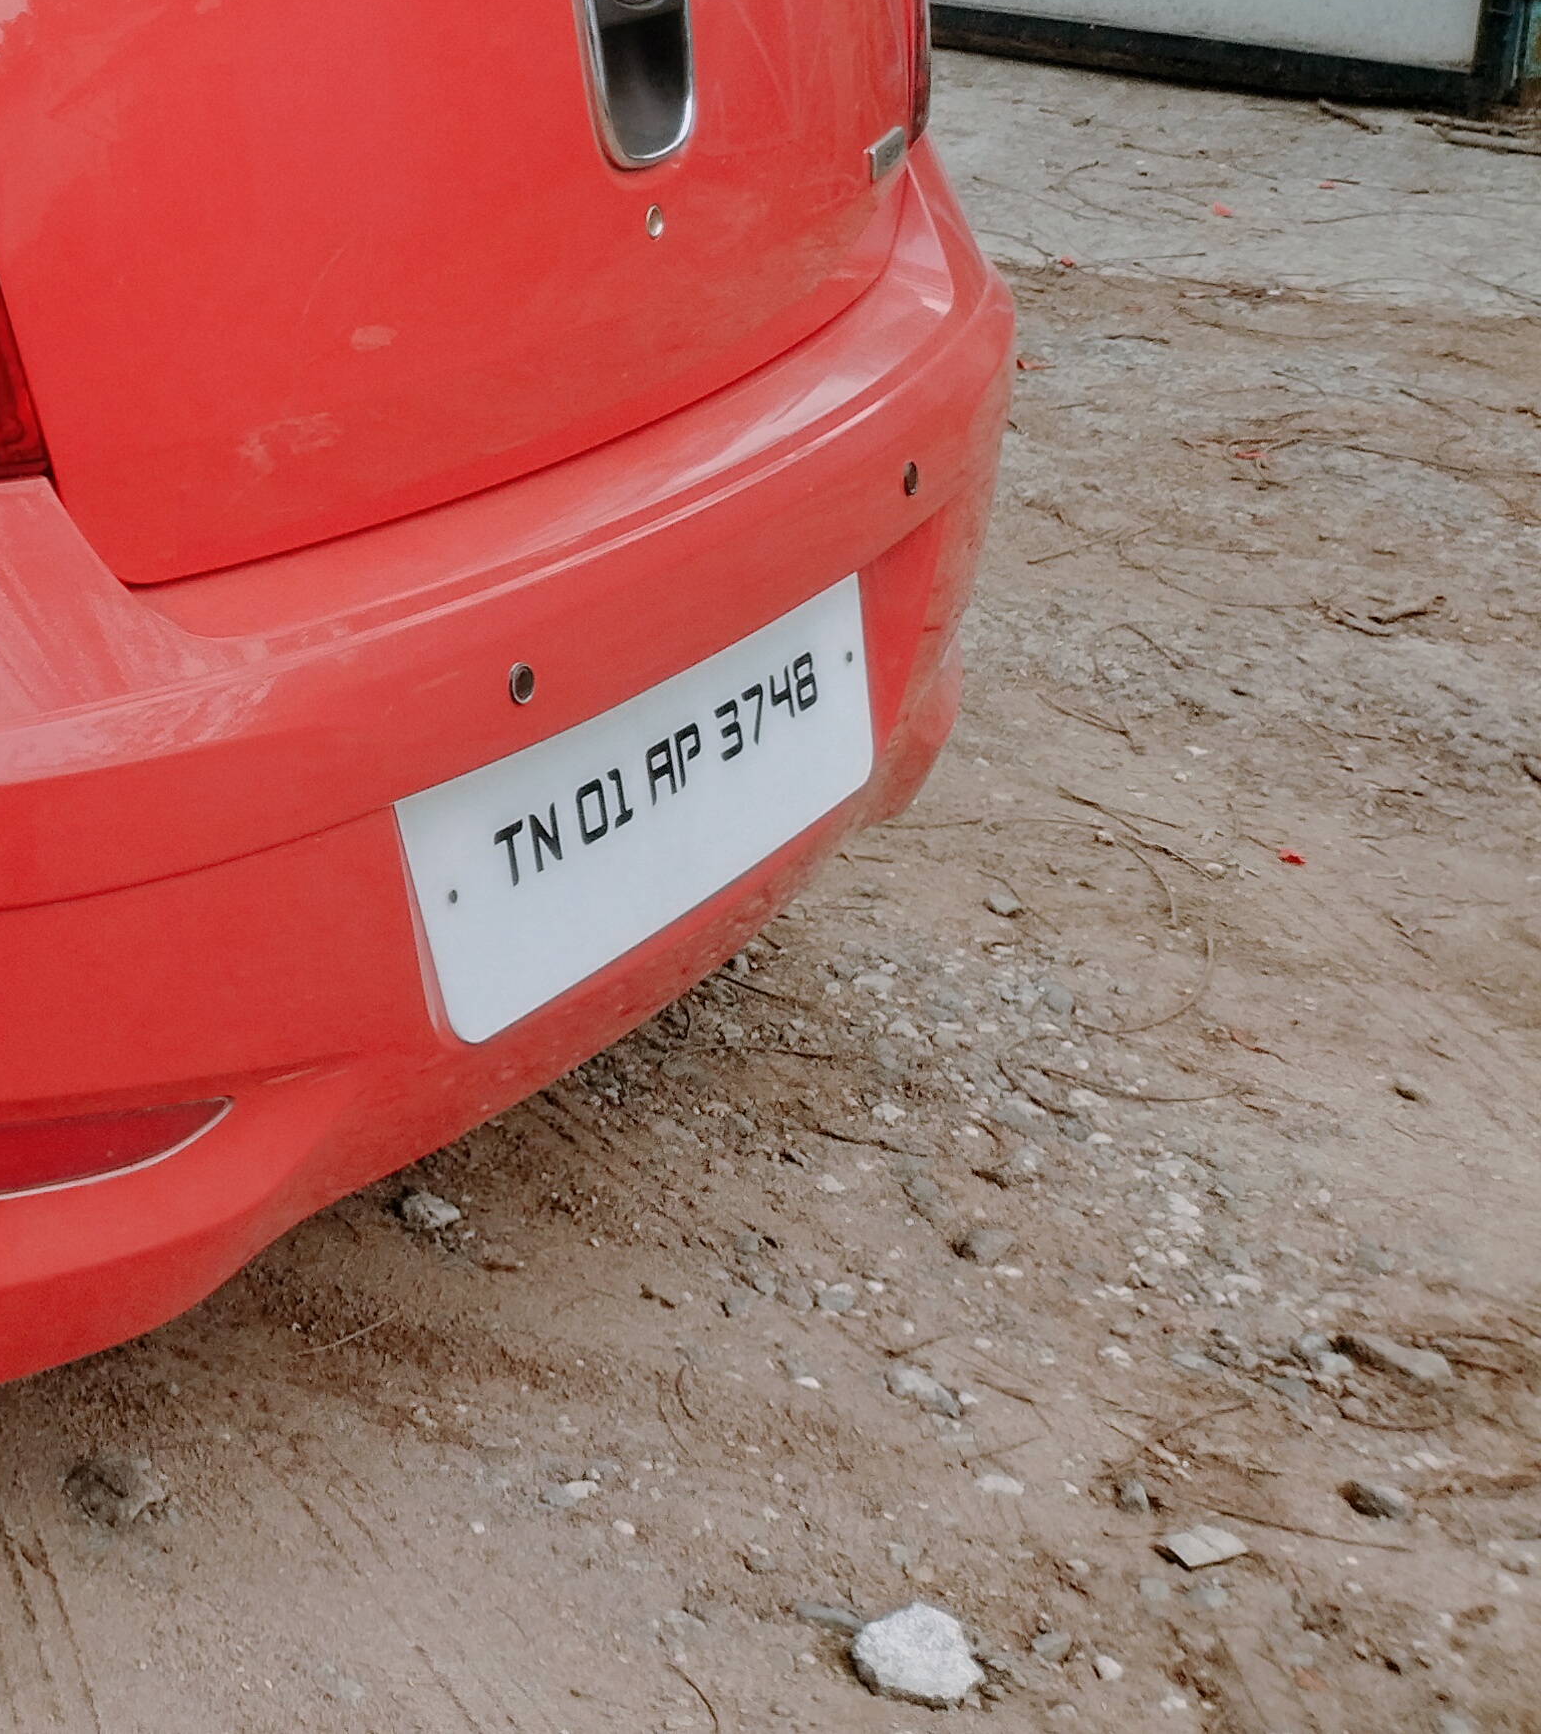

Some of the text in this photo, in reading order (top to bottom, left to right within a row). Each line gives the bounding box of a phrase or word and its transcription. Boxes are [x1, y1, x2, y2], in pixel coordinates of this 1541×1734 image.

[493, 651, 819, 887] TN 01 AP 3748
